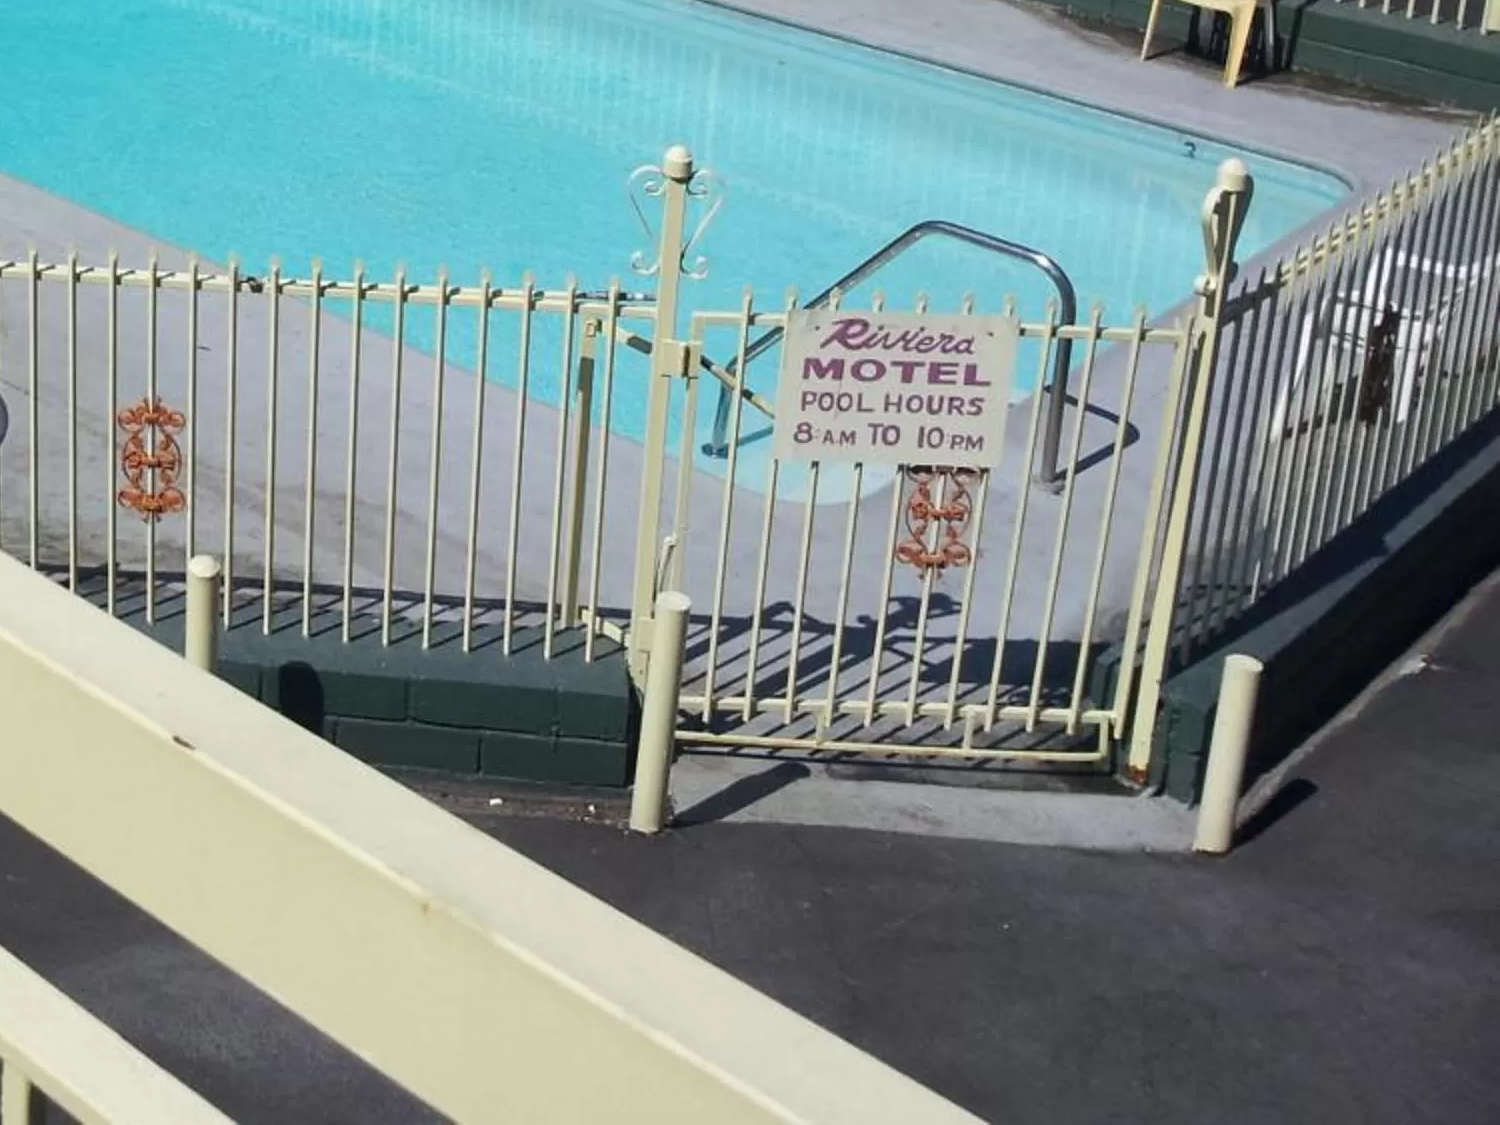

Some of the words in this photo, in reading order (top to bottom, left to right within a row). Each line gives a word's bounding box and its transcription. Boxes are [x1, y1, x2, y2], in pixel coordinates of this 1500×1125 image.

[820, 317, 975, 355] Riviera
[802, 357, 992, 387] MOTEL
[801, 390, 875, 413] POOL
[884, 393, 986, 416] HOURS
[867, 423, 902, 446] TO
